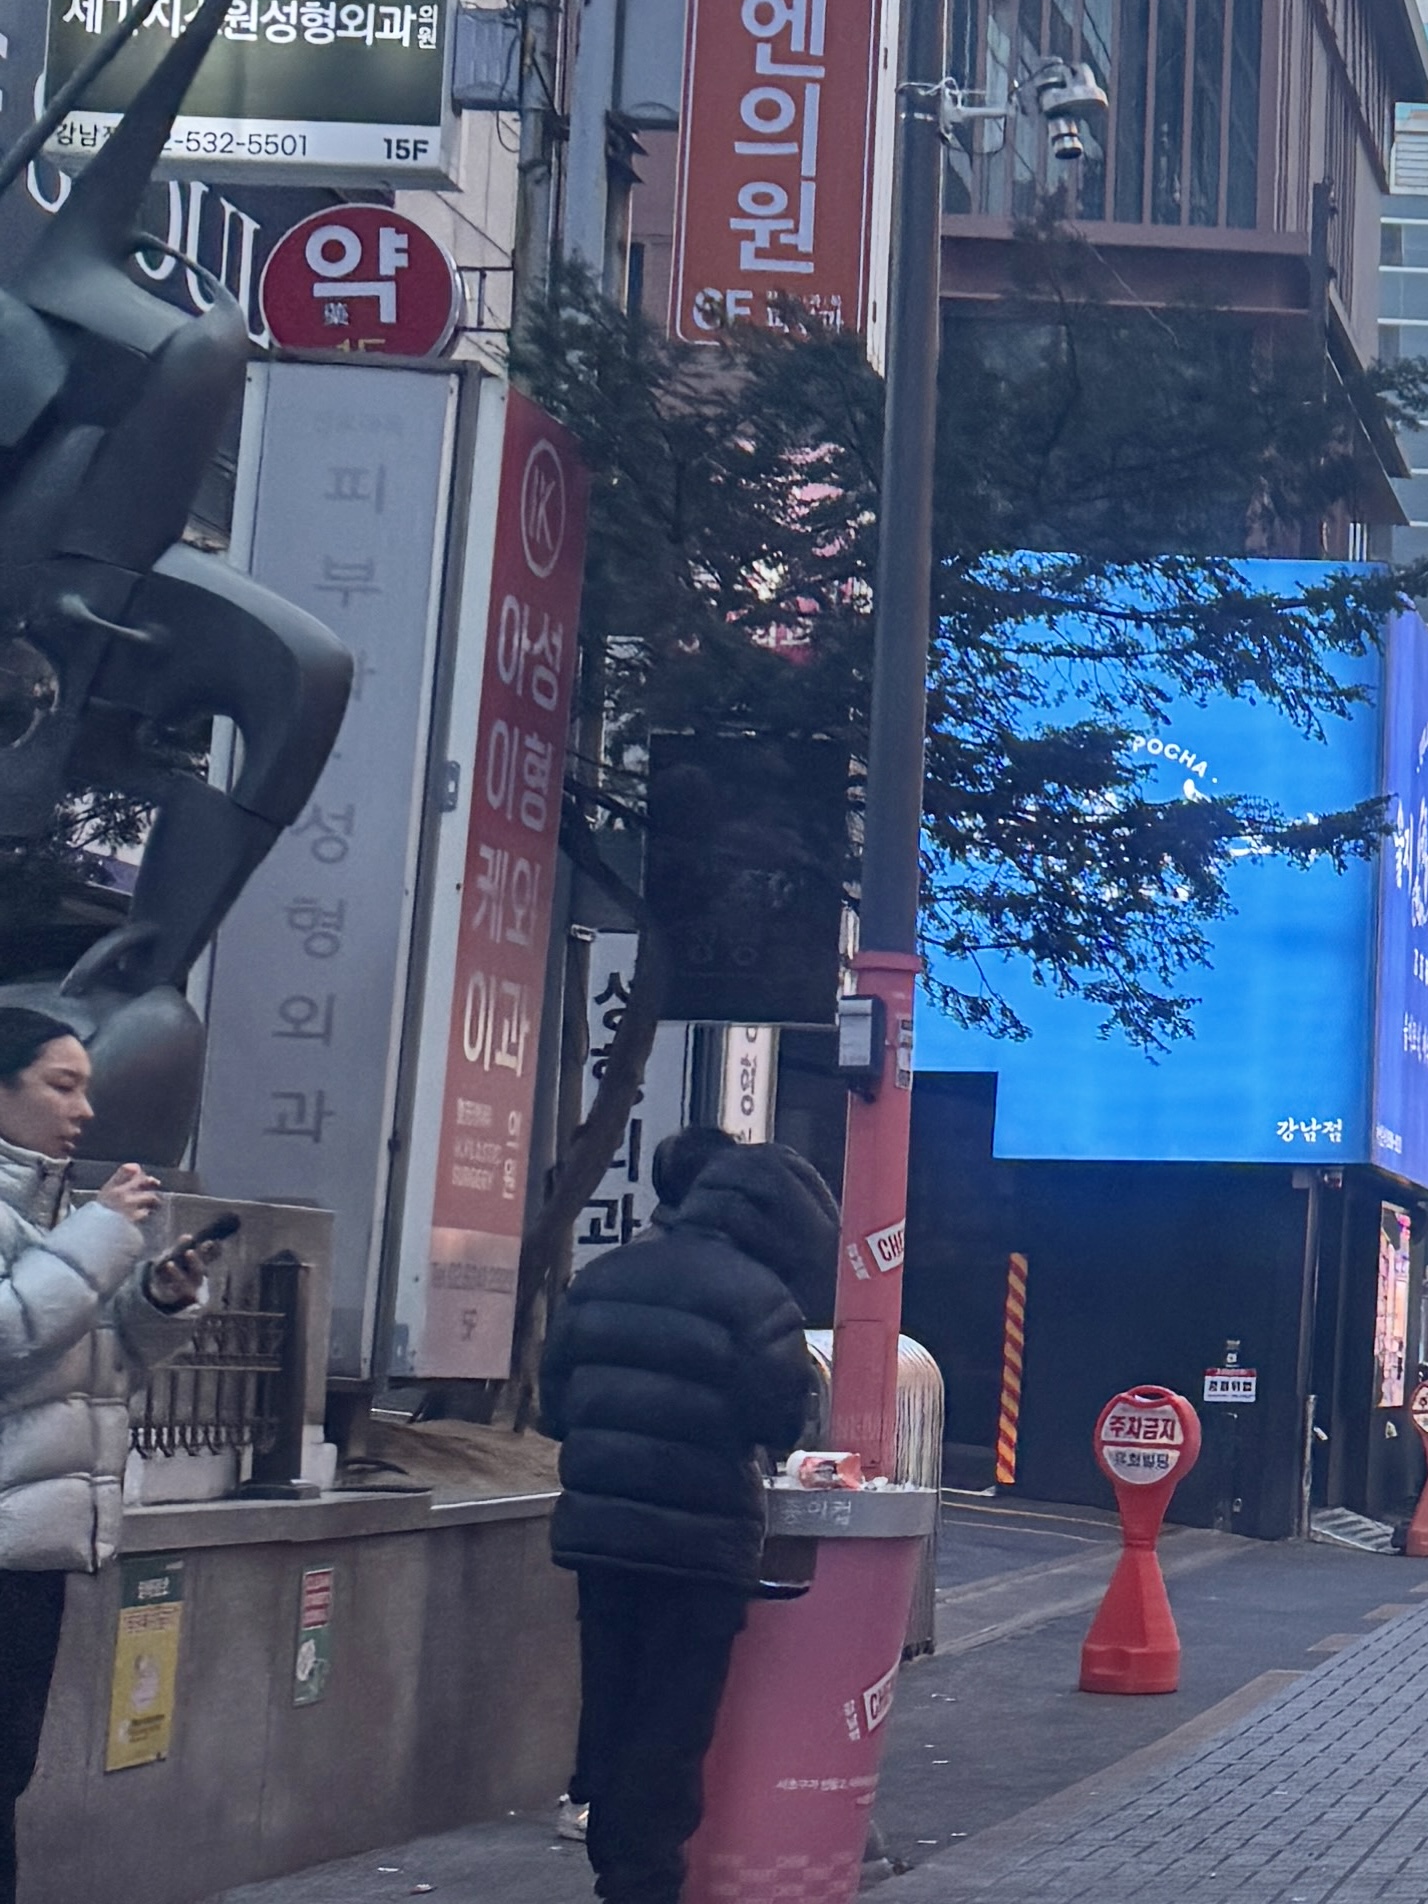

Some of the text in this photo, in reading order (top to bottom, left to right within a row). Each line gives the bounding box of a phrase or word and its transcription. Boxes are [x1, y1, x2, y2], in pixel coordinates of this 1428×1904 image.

[161, 132, 310, 158] -532-5501
[383, 136, 430, 161] 15F
[305, 224, 408, 325] 약
[1275, 1117, 1345, 1145] 강남점
[1109, 1414, 1176, 1442] 주차금지
